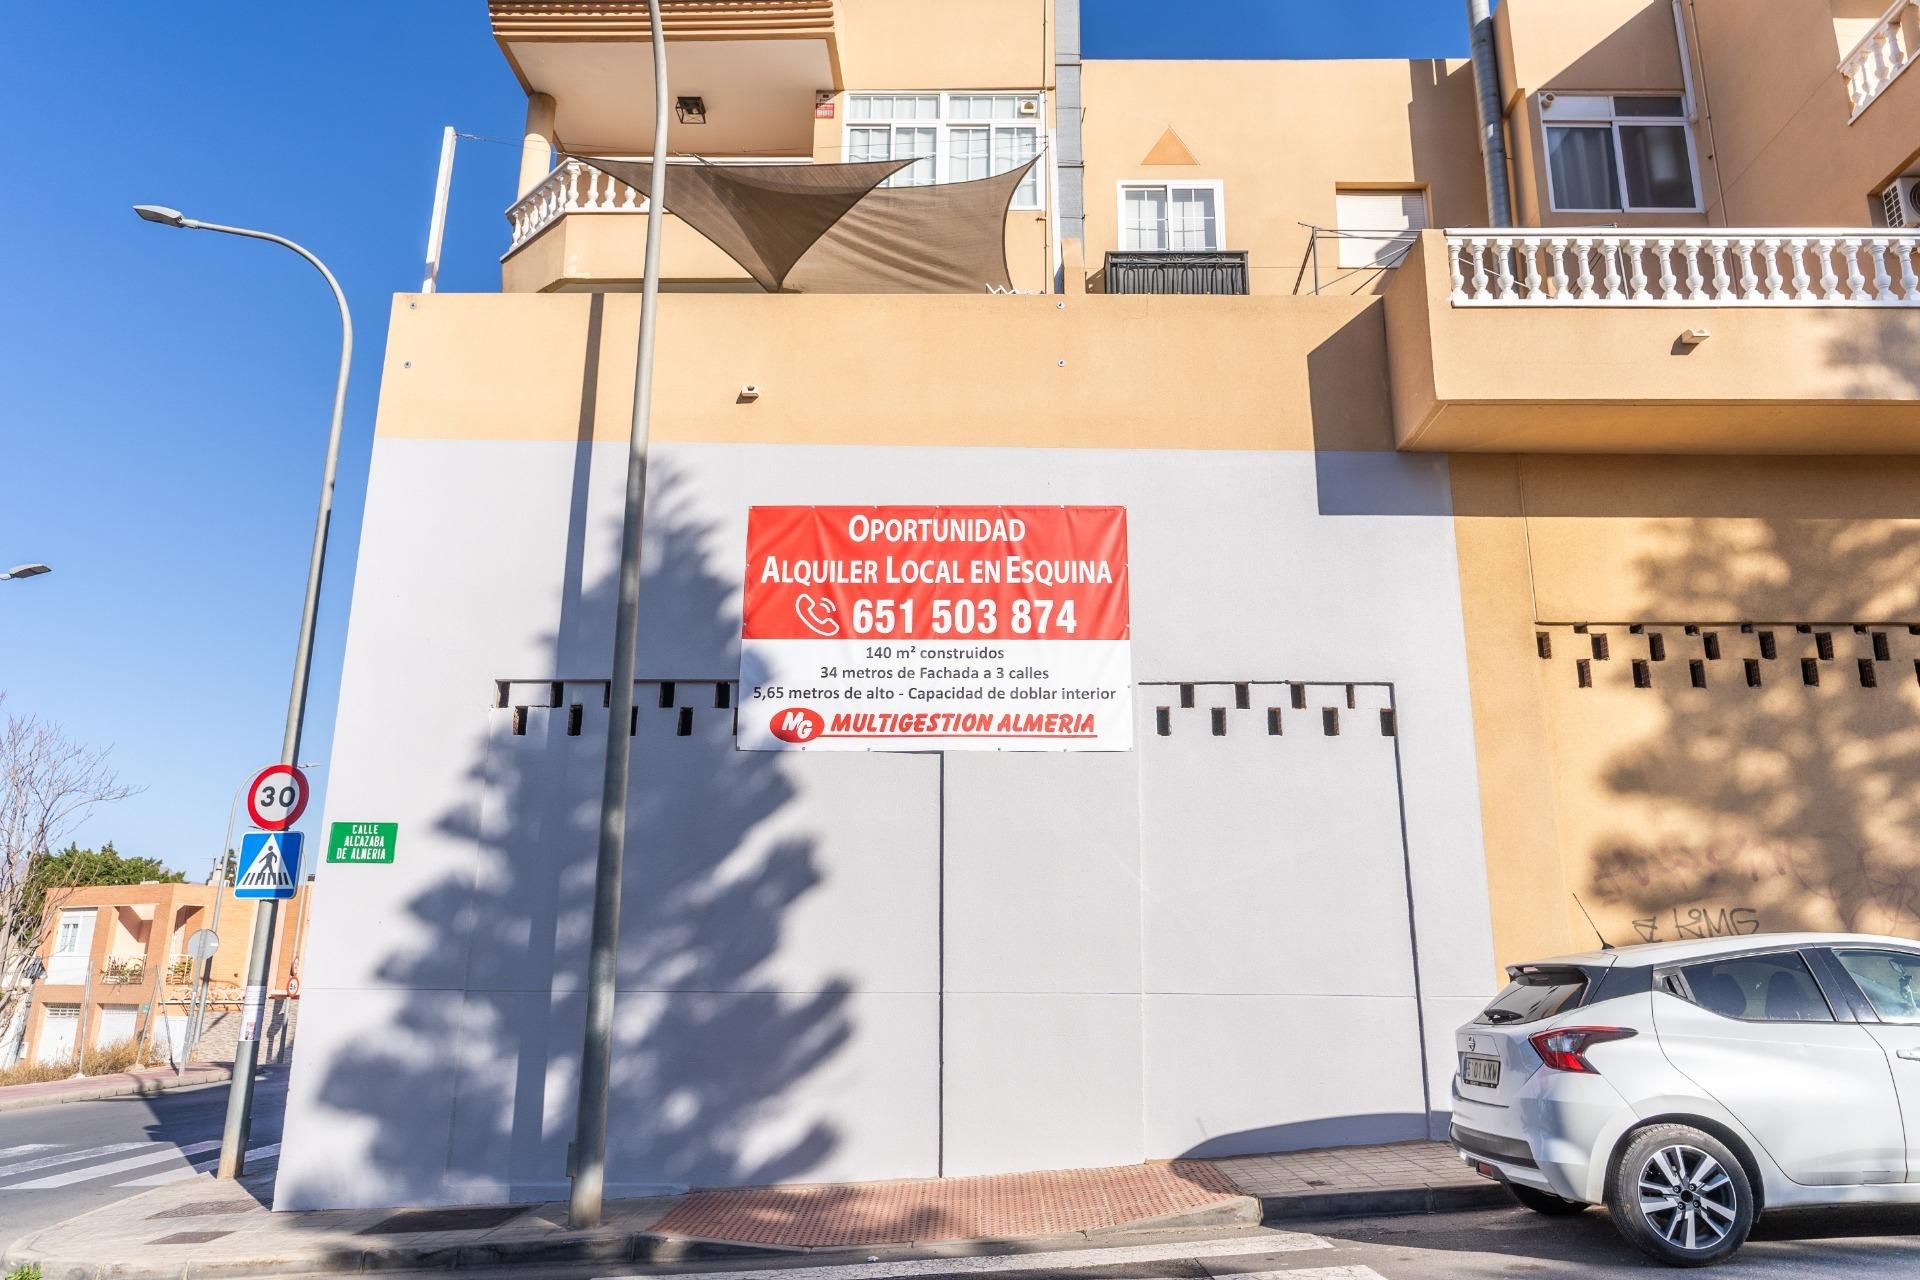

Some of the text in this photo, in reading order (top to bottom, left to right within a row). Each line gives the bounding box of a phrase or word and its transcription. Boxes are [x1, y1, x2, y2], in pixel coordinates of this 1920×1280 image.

[848, 514, 1026, 542] OPORTUNIDAD
[760, 555, 1113, 587] ALQUILER LOCAL EN ESQUINA
[852, 598, 1077, 634] 651 503 874
[866, 646, 892, 659] 140
[920, 646, 1005, 659] construidos
[820, 666, 1049, 679] 34 metros de Fachada a 3 calles
[753, 686, 784, 701] 5,65
[788, 688, 840, 700] metros
[844, 686, 862, 699] de
[866, 686, 894, 700] alto
[908, 686, 983, 702] Capacidad
[987, 686, 1006, 700] de
[1010, 686, 1057, 700] doblar
[1062, 687, 1117, 700] interior
[781, 711, 813, 739] MG
[830, 712, 1095, 733] MULTIGESTION ALMERIA
[260, 786, 296, 807] 30
[352, 824, 379, 834] CALLE
[344, 835, 385, 847] ALCAZABA
[336, 847, 348, 860] DE
